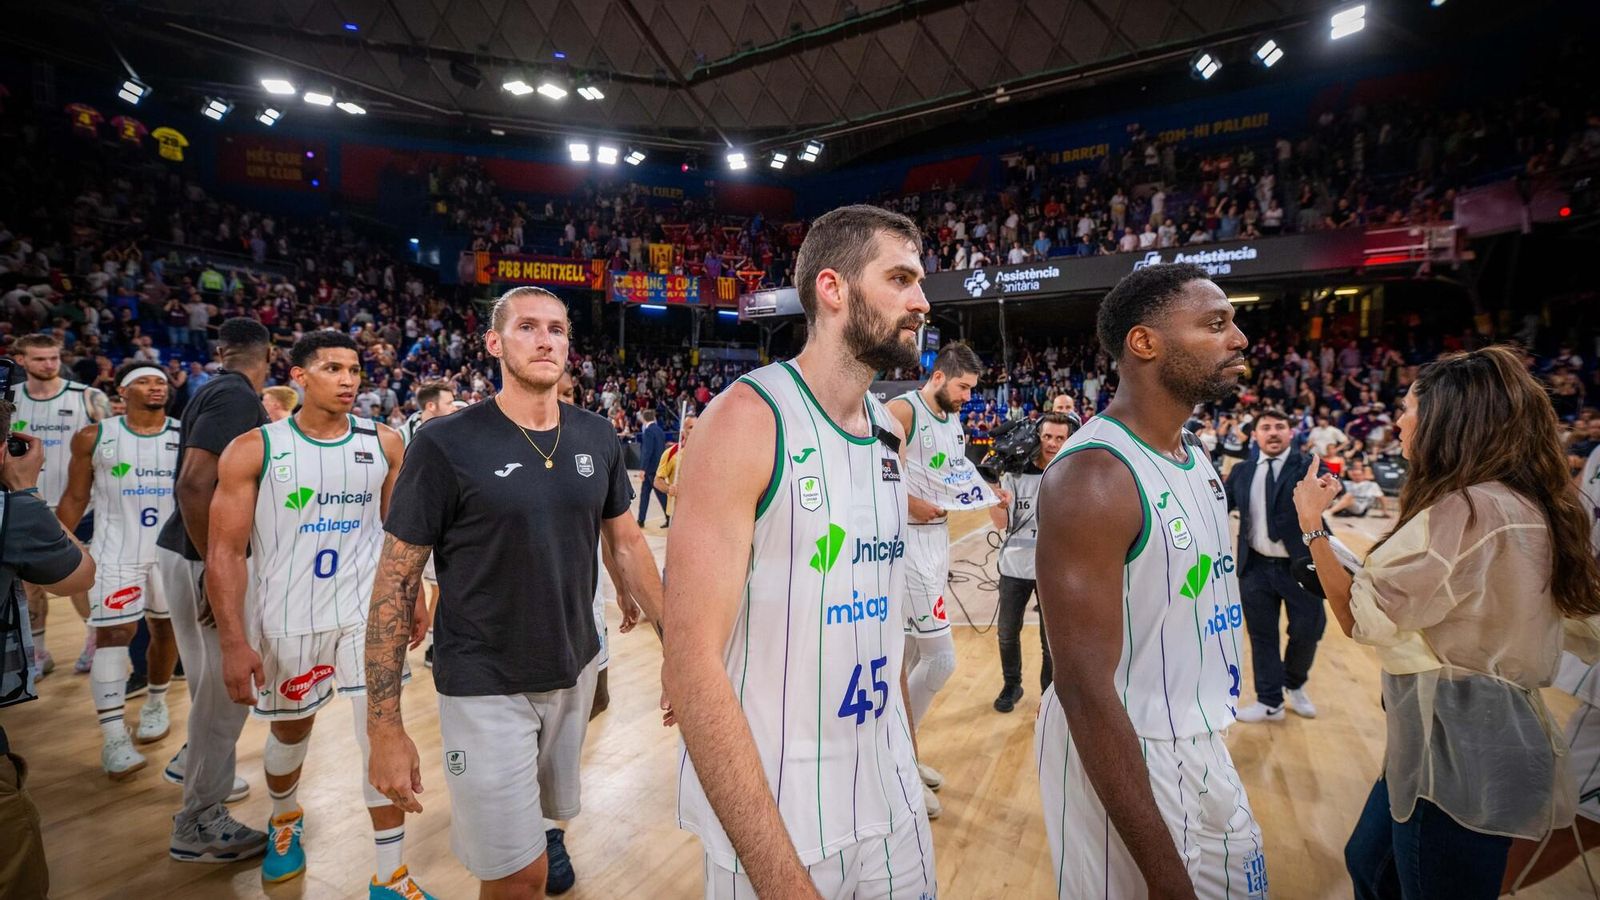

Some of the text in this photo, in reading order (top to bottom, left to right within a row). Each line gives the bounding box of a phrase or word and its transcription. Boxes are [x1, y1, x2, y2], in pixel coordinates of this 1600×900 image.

[1174, 246, 1258, 263] Assistència
[523, 262, 585, 282] MERITXELL
[995, 266, 1060, 283] Assistència
[30, 423, 71, 433] Unicaja
[135, 467, 176, 480] Unicaj
[317, 490, 373, 506] Unicaja
[140, 507, 158, 527] 6
[299, 517, 360, 533] málaga
[313, 549, 339, 579] 0
[837, 655, 889, 725] 45
